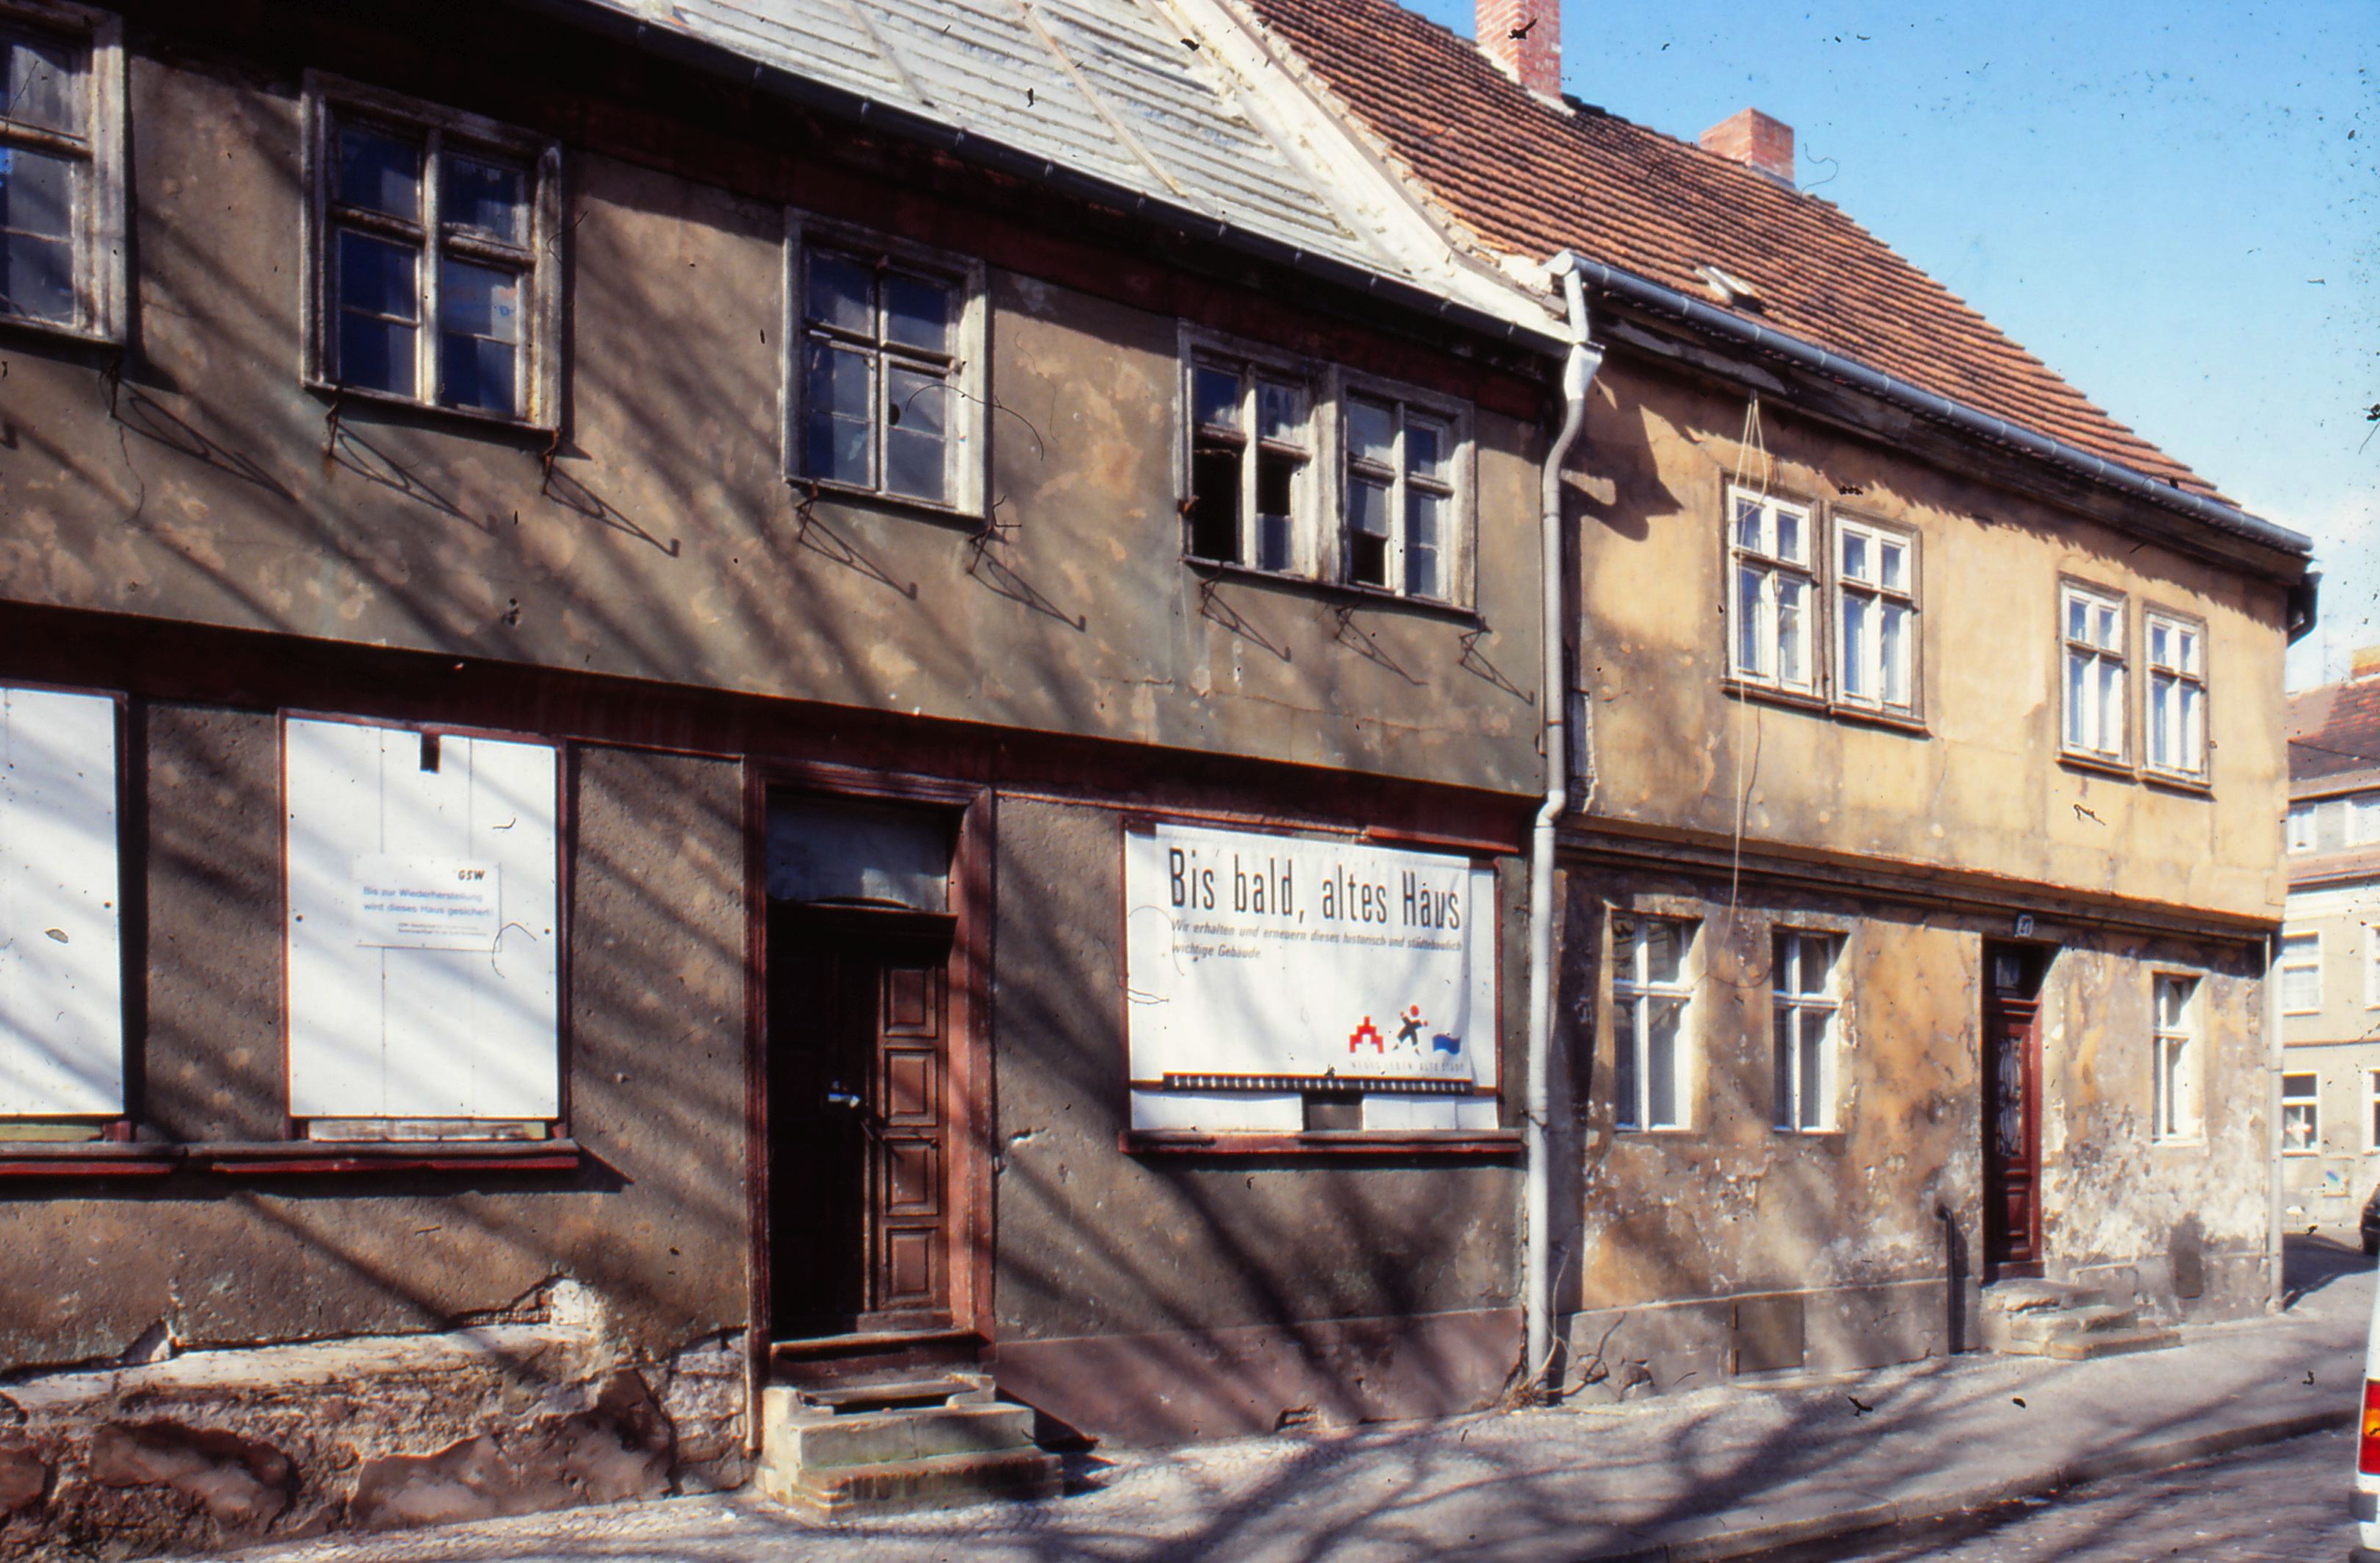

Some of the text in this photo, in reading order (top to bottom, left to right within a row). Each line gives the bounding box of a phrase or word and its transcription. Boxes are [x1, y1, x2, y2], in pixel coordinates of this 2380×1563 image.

[458, 870, 485, 881] GSW
[1169, 847, 1460, 931] Bis bald, altes Haus
[1172, 918, 1189, 932] Wir
[1193, 922, 1235, 936] erhalten
[1239, 925, 1260, 937] und
[1310, 929, 1339, 943] dieses
[1343, 931, 1385, 946] historisch
[1388, 936, 1405, 947] und
[1172, 942, 1214, 957] wichtige
